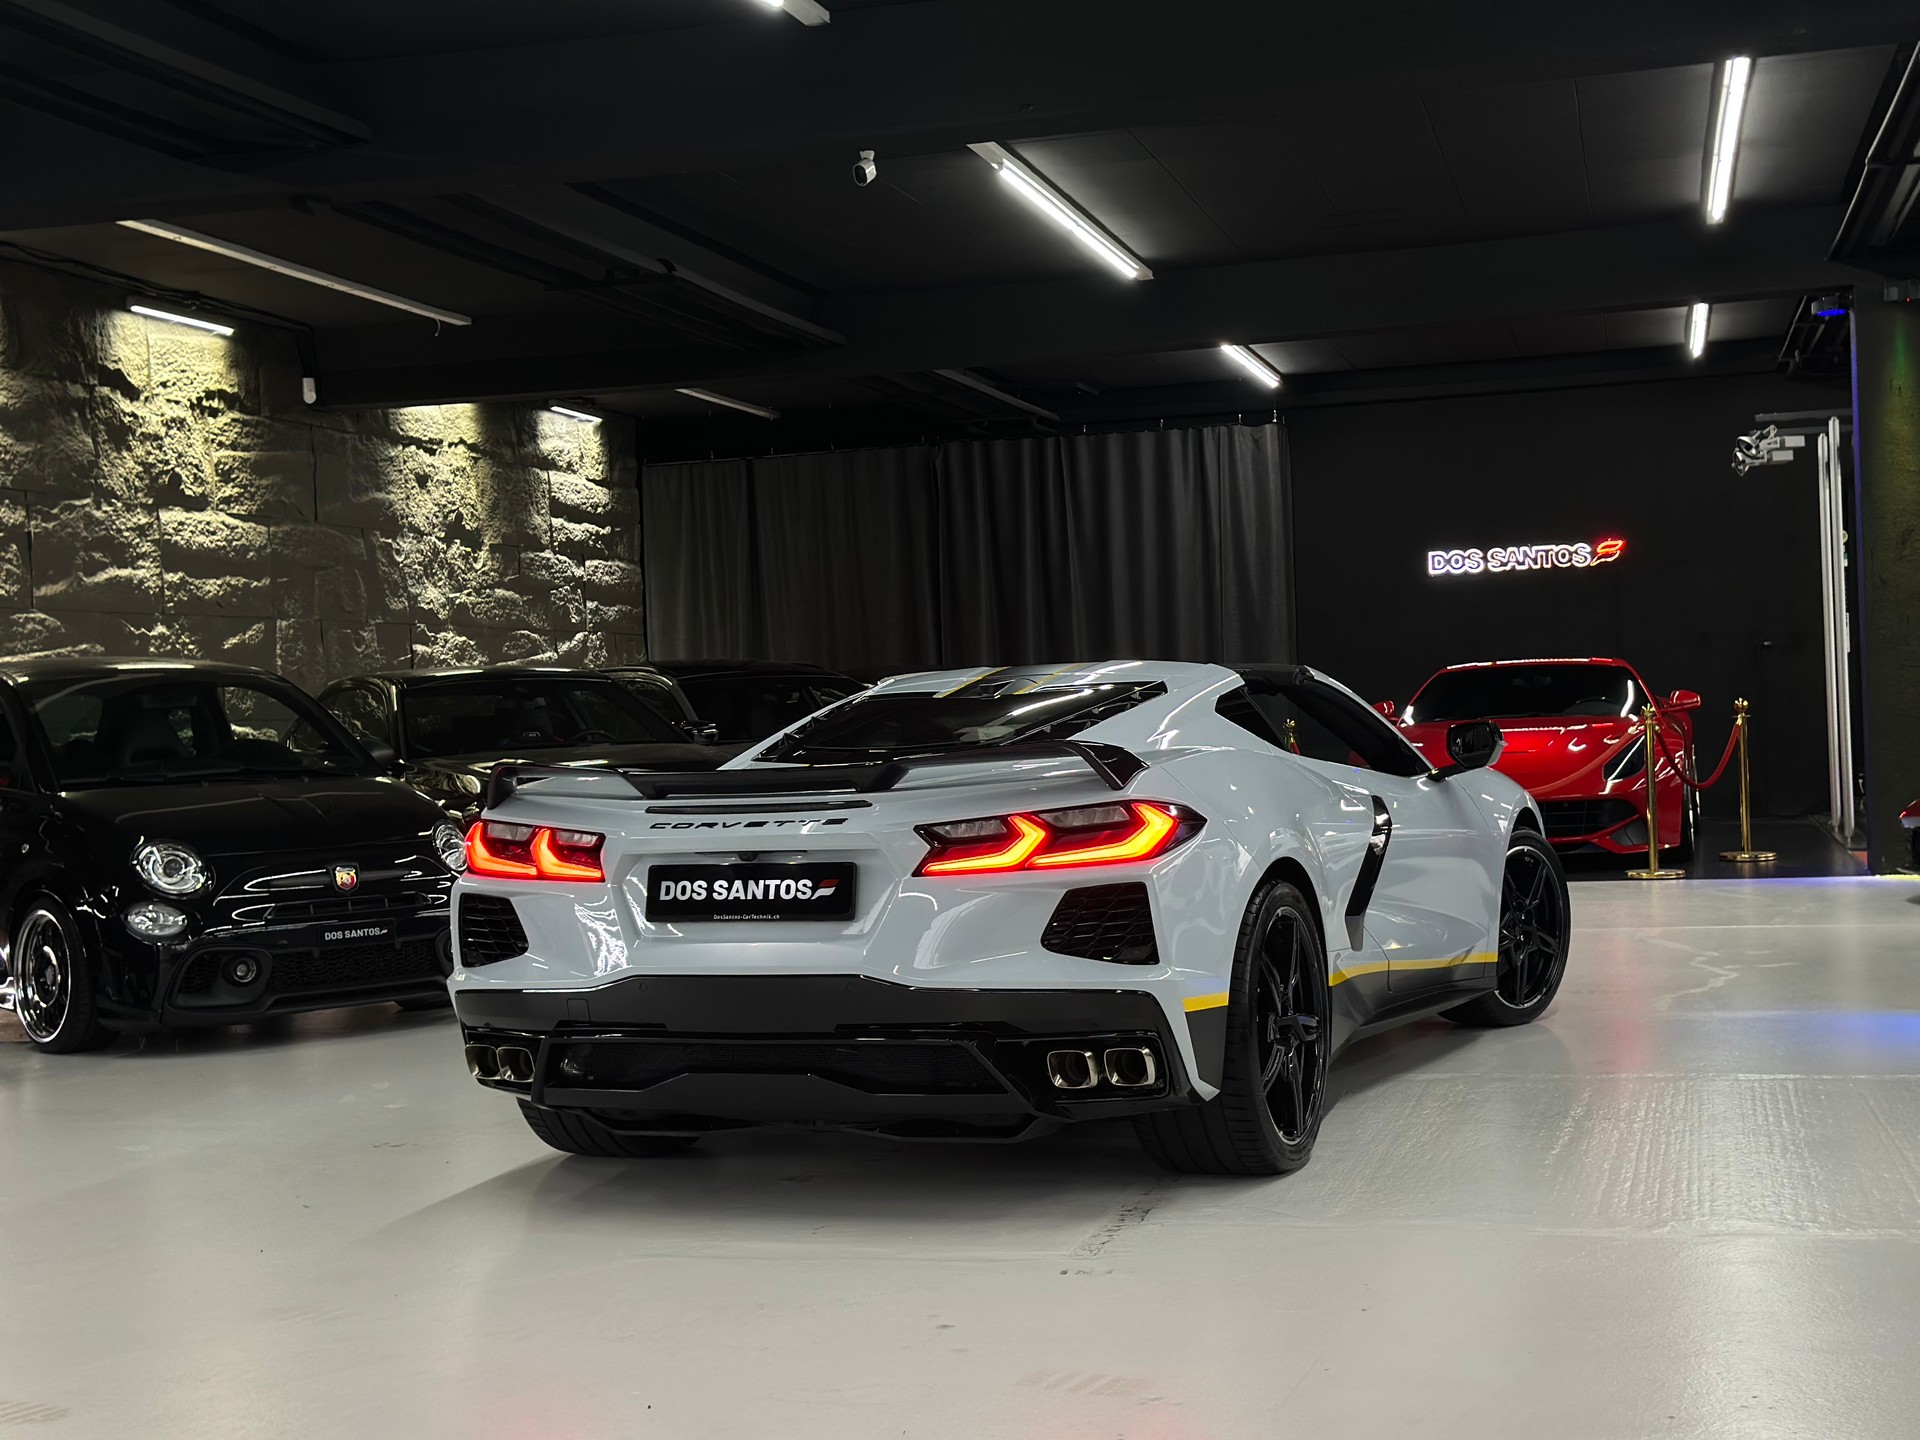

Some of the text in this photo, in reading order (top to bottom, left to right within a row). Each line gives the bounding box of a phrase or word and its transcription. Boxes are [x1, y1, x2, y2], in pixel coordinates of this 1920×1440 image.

[1428, 542, 1592, 575] DOS SANTOS
[649, 817, 849, 830] CORVETTE
[659, 879, 813, 901] DOS SANTOS
[324, 927, 381, 940] DOS SANTOS
